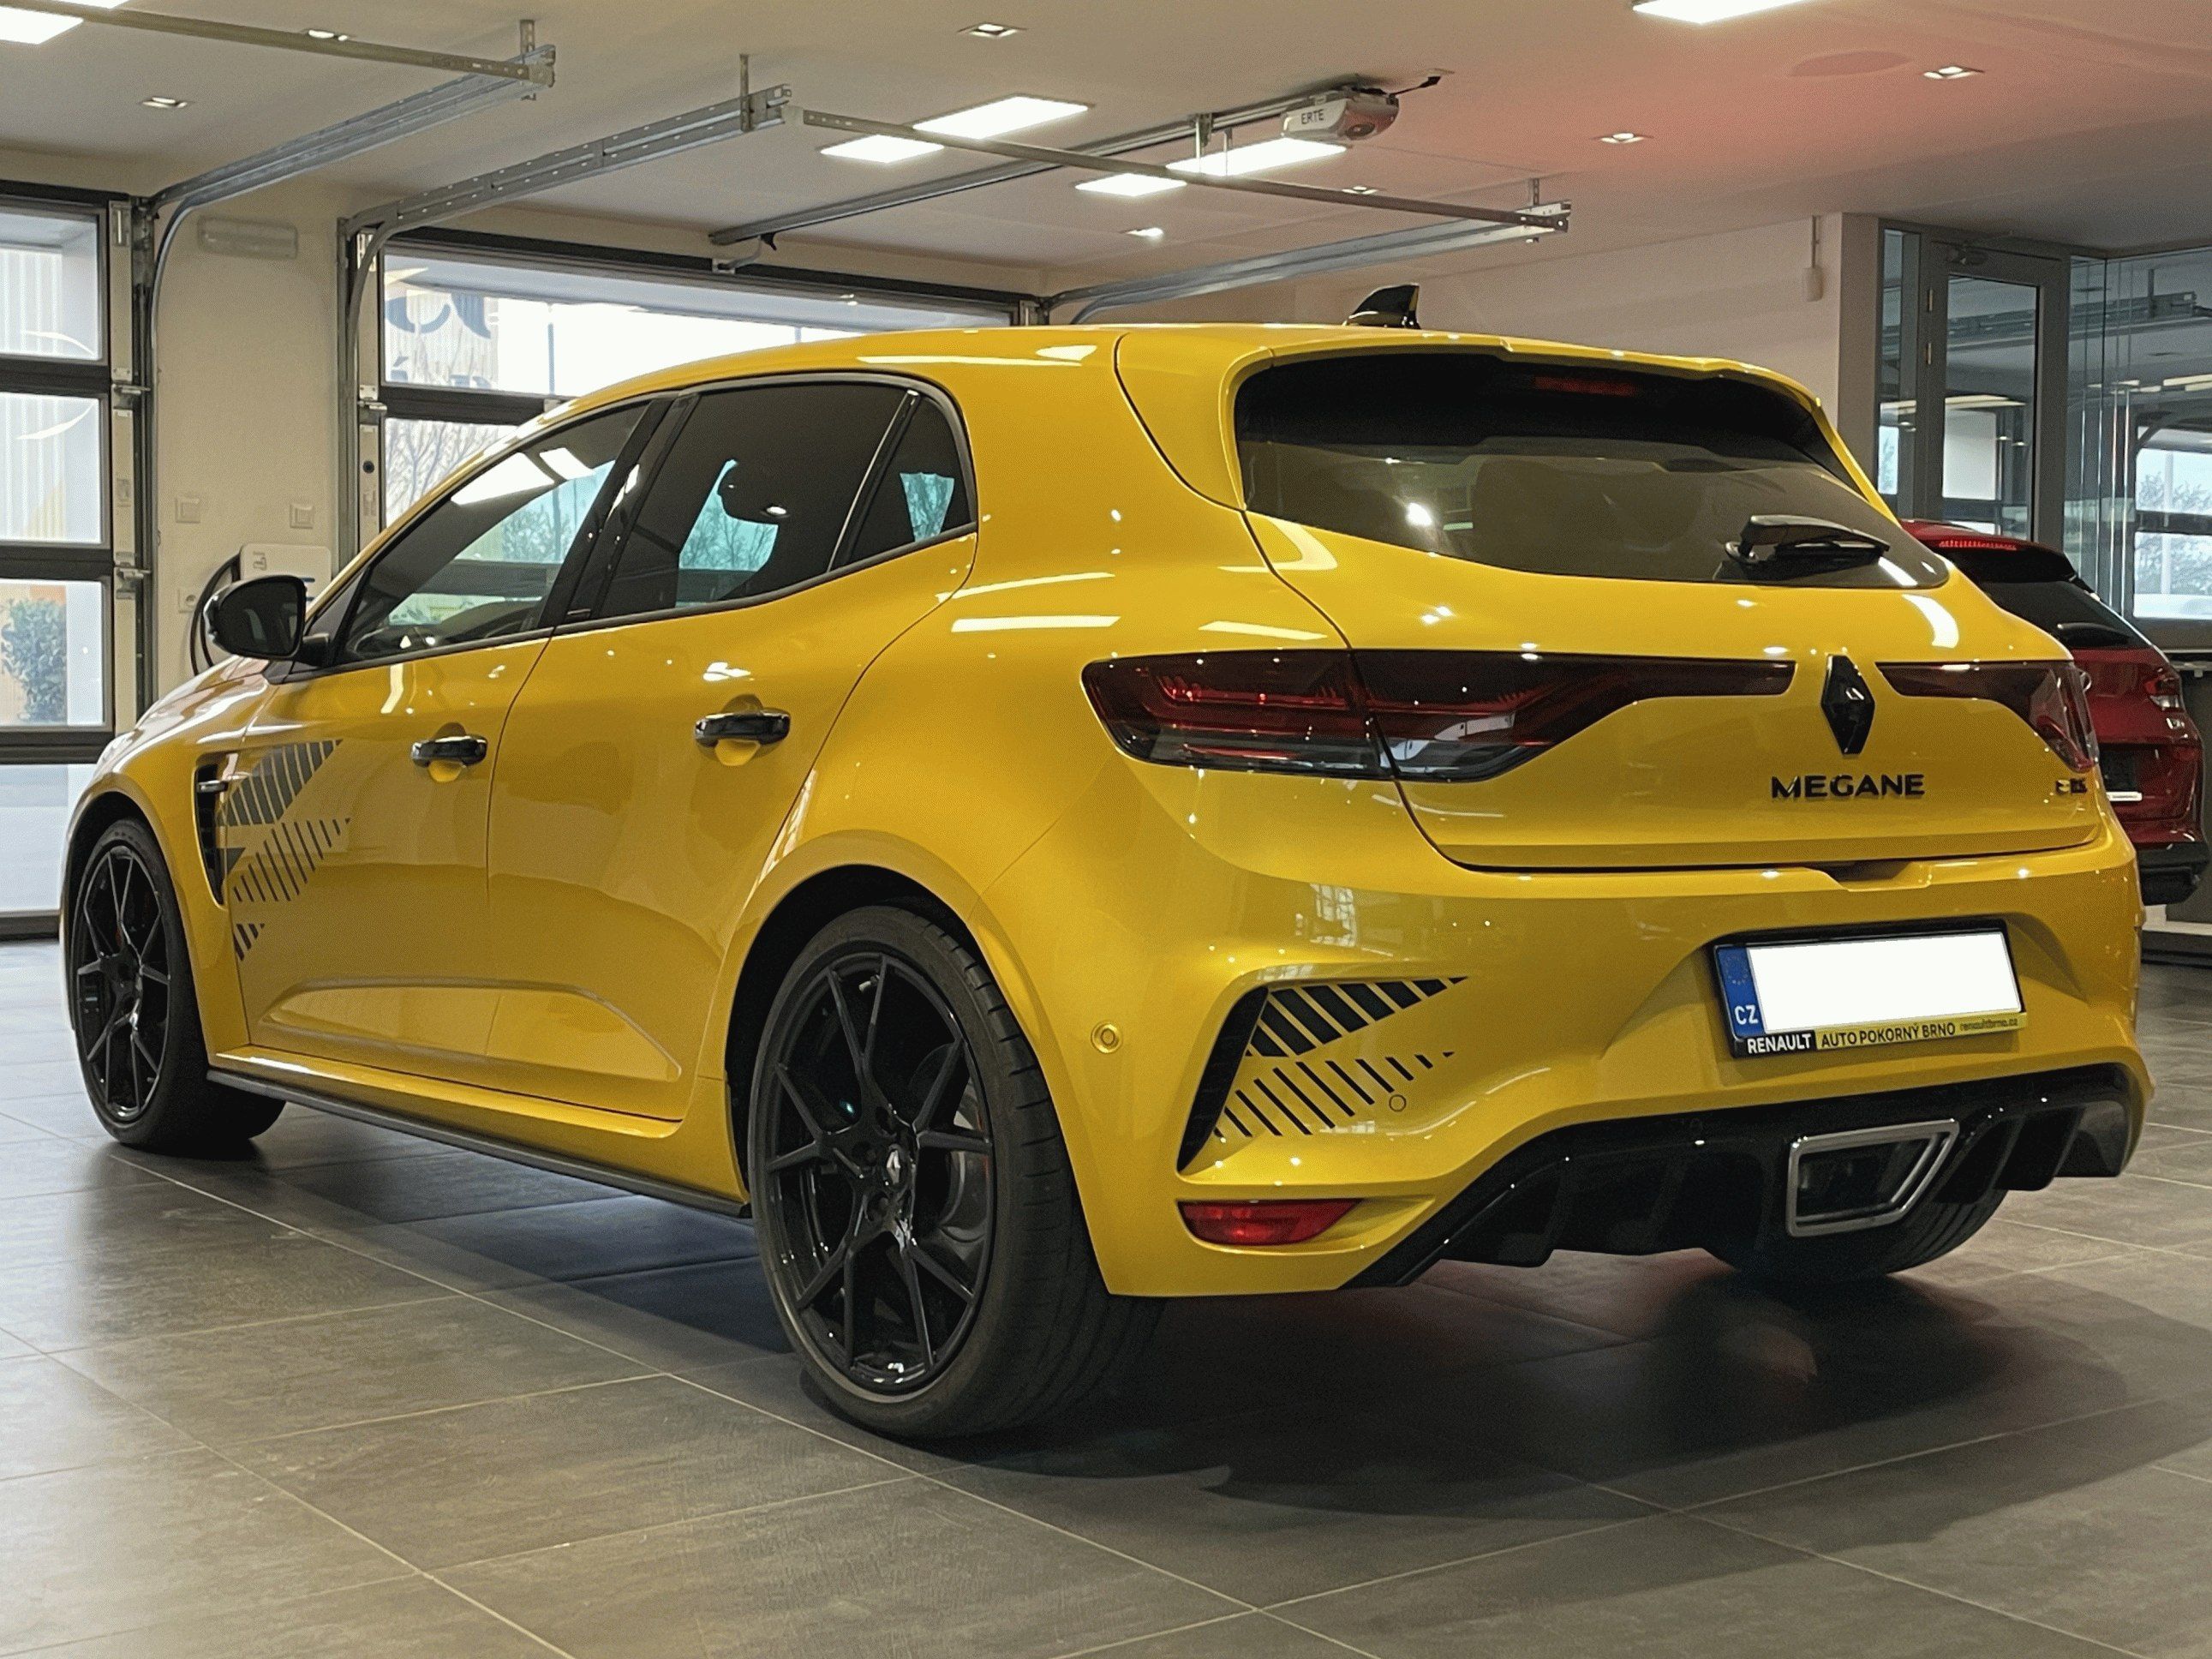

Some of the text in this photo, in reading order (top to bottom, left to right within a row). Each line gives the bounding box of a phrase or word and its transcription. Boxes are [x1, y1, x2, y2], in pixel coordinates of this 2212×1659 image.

[1301, 109, 1324, 124] ERTE
[1771, 773, 1926, 799] MEGANE
[1734, 1004, 1759, 1025] CZ
[1748, 1033, 1812, 1054] RENAULT
[1820, 1032, 1857, 1047] AUTO
[1859, 1022, 1919, 1044] POKORNÝ
[1922, 1022, 1956, 1039] BRNO
